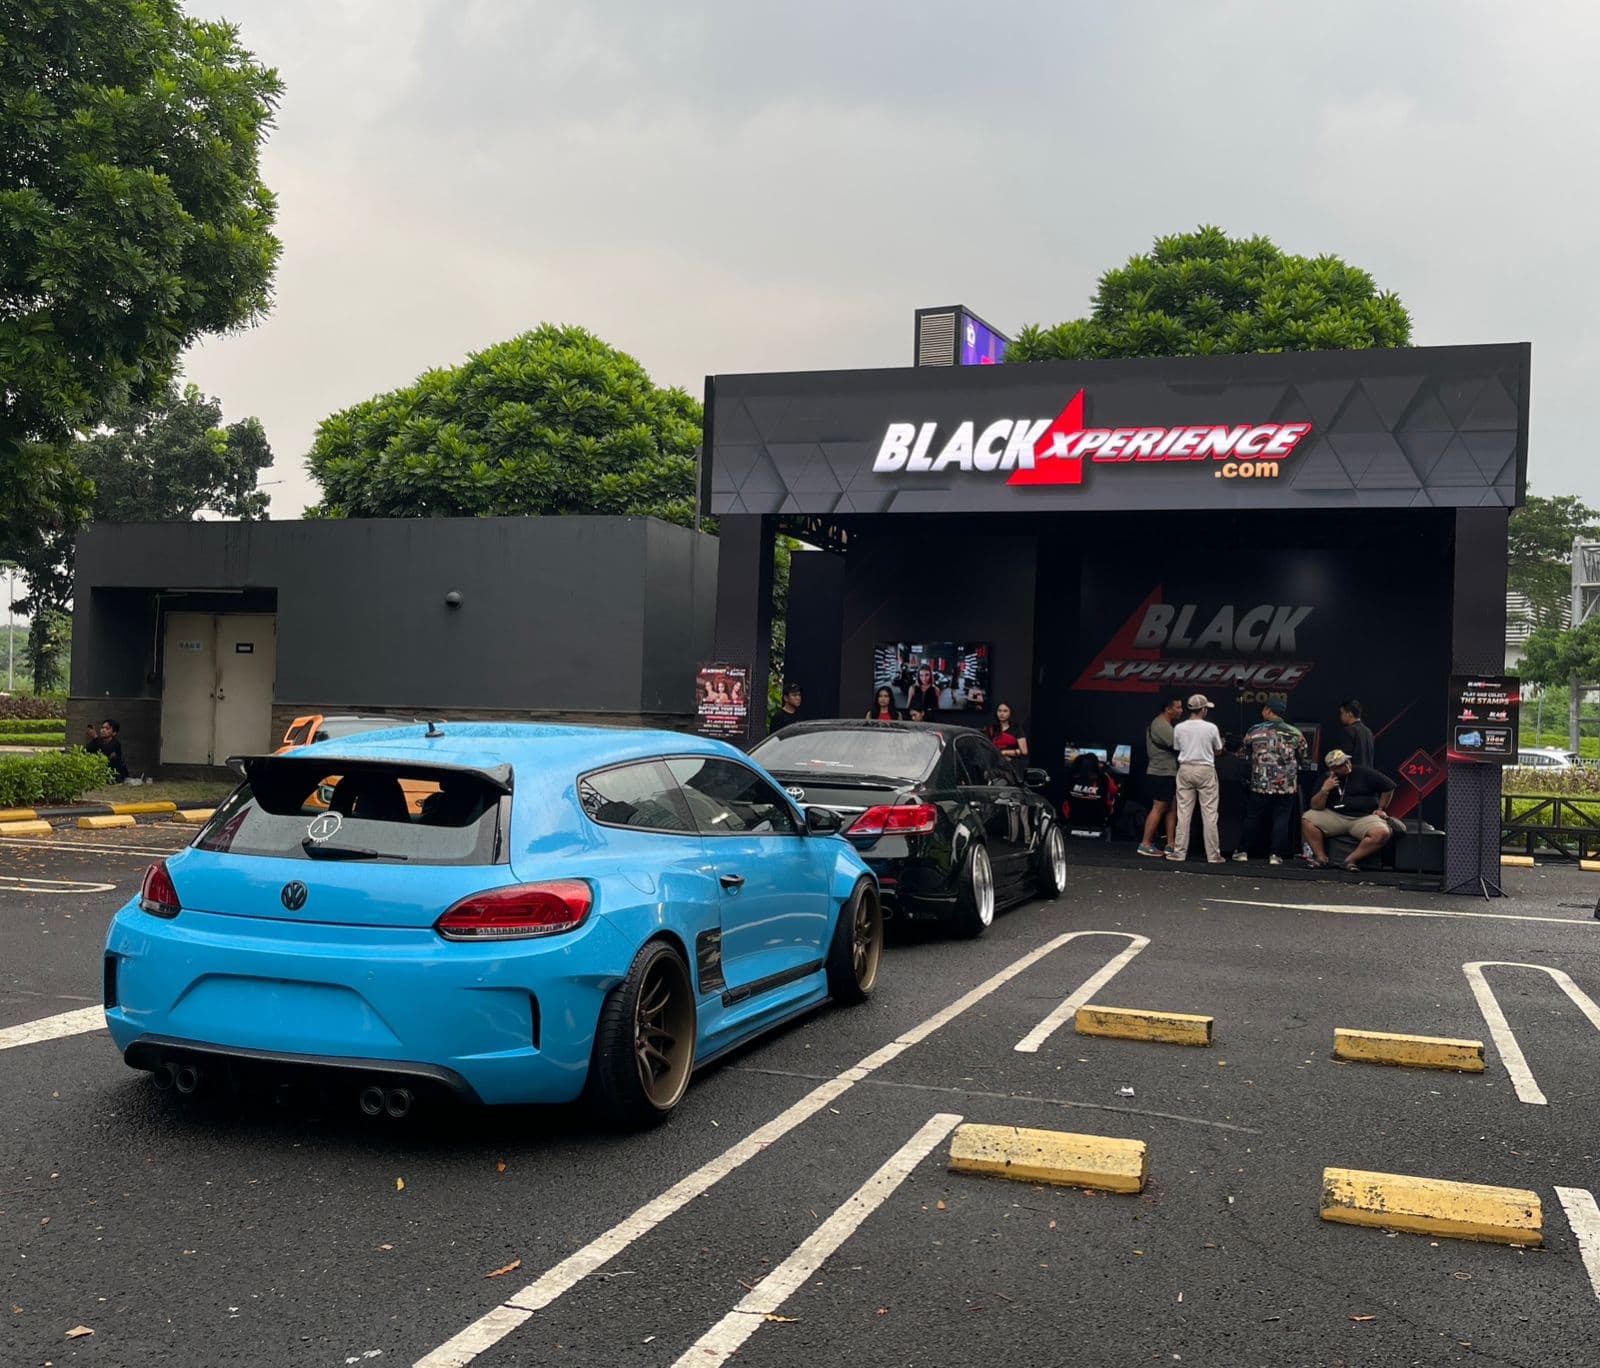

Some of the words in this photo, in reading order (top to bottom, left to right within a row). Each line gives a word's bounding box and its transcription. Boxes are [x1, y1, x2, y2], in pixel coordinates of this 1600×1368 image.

[873, 419, 1053, 472] BLACK
[1040, 422, 1311, 463] XPERIENCE
[1214, 462, 1279, 479] .com
[1134, 604, 1313, 651] BLACK
[1093, 660, 1312, 686] XPERIENCE
[1461, 697, 1476, 705] THE
[1476, 698, 1510, 706] STAMPS
[1409, 765, 1433, 776] 21+
[1073, 783, 1100, 794] BLACK
